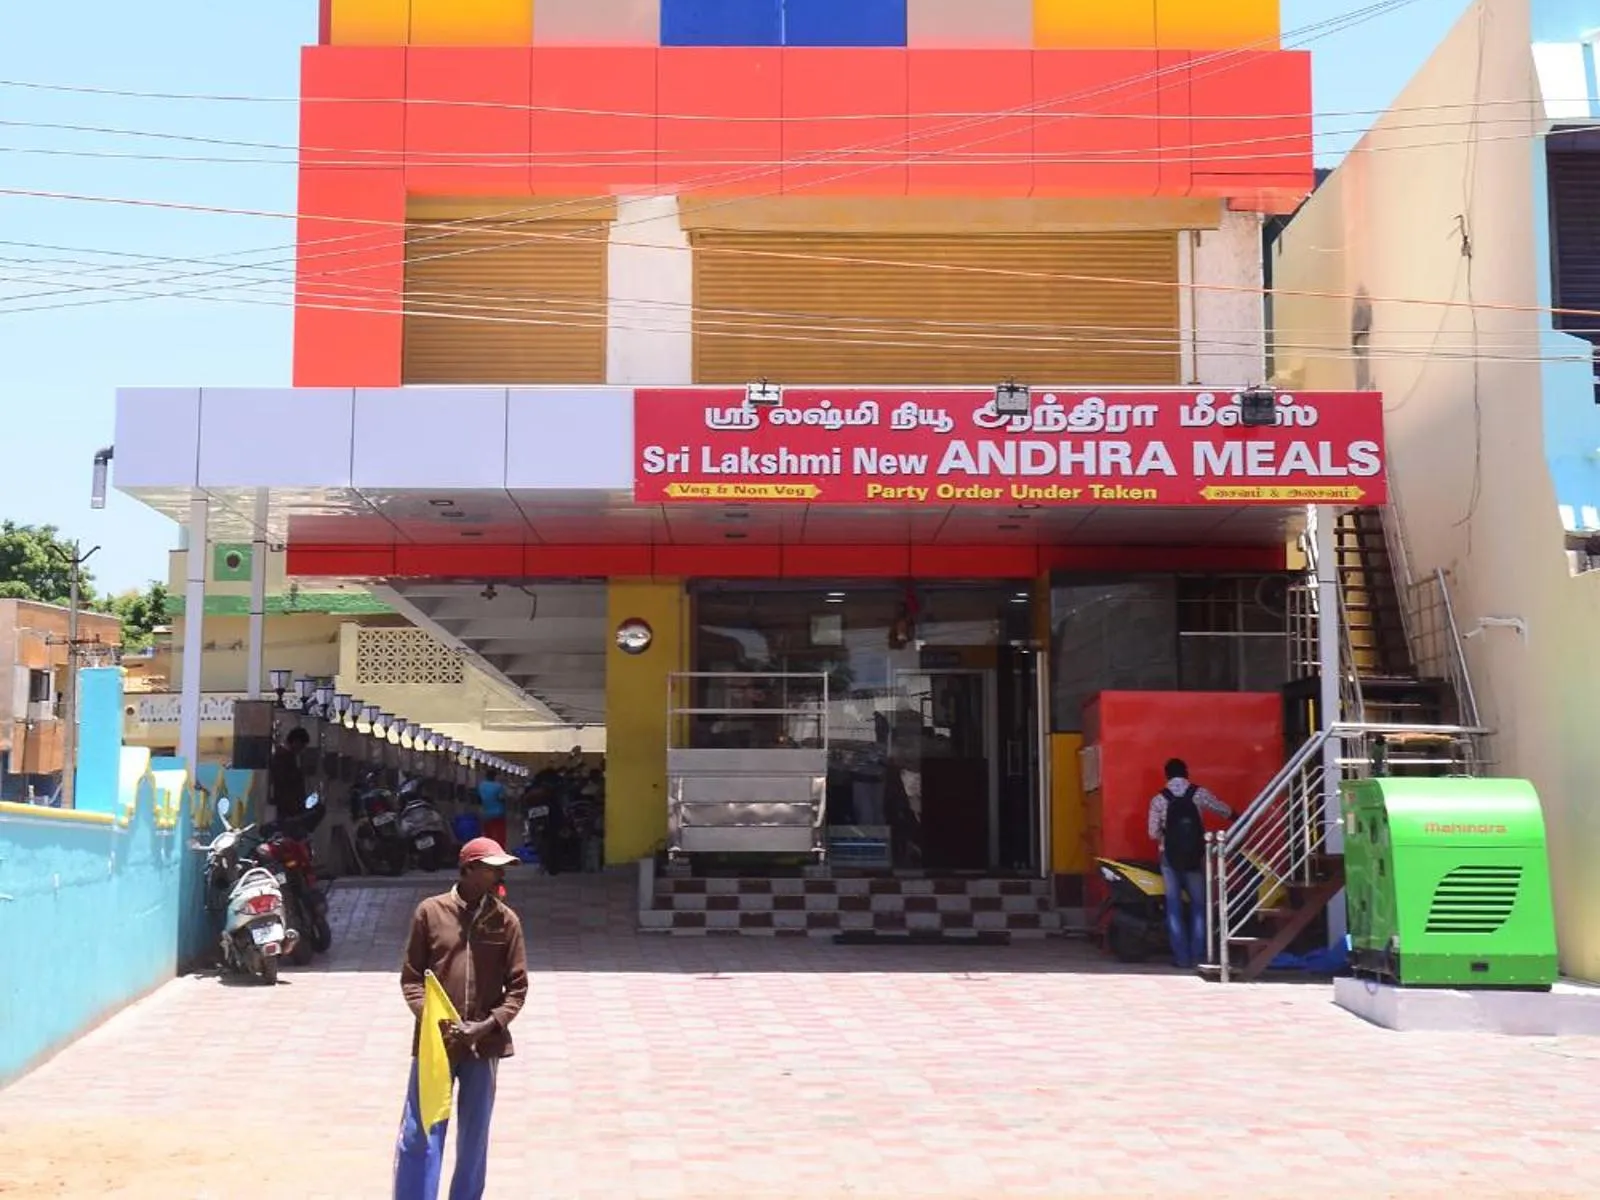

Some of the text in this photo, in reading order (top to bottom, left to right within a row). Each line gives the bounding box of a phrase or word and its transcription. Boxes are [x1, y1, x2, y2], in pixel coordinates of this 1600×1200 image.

[890, 401, 954, 433] நியூ
[643, 440, 1381, 476] Sri Lakshmi New ANDHRA MEALS
[679, 485, 806, 497] Veg & Non Veg
[866, 483, 1158, 500] Party Order Under Taken
